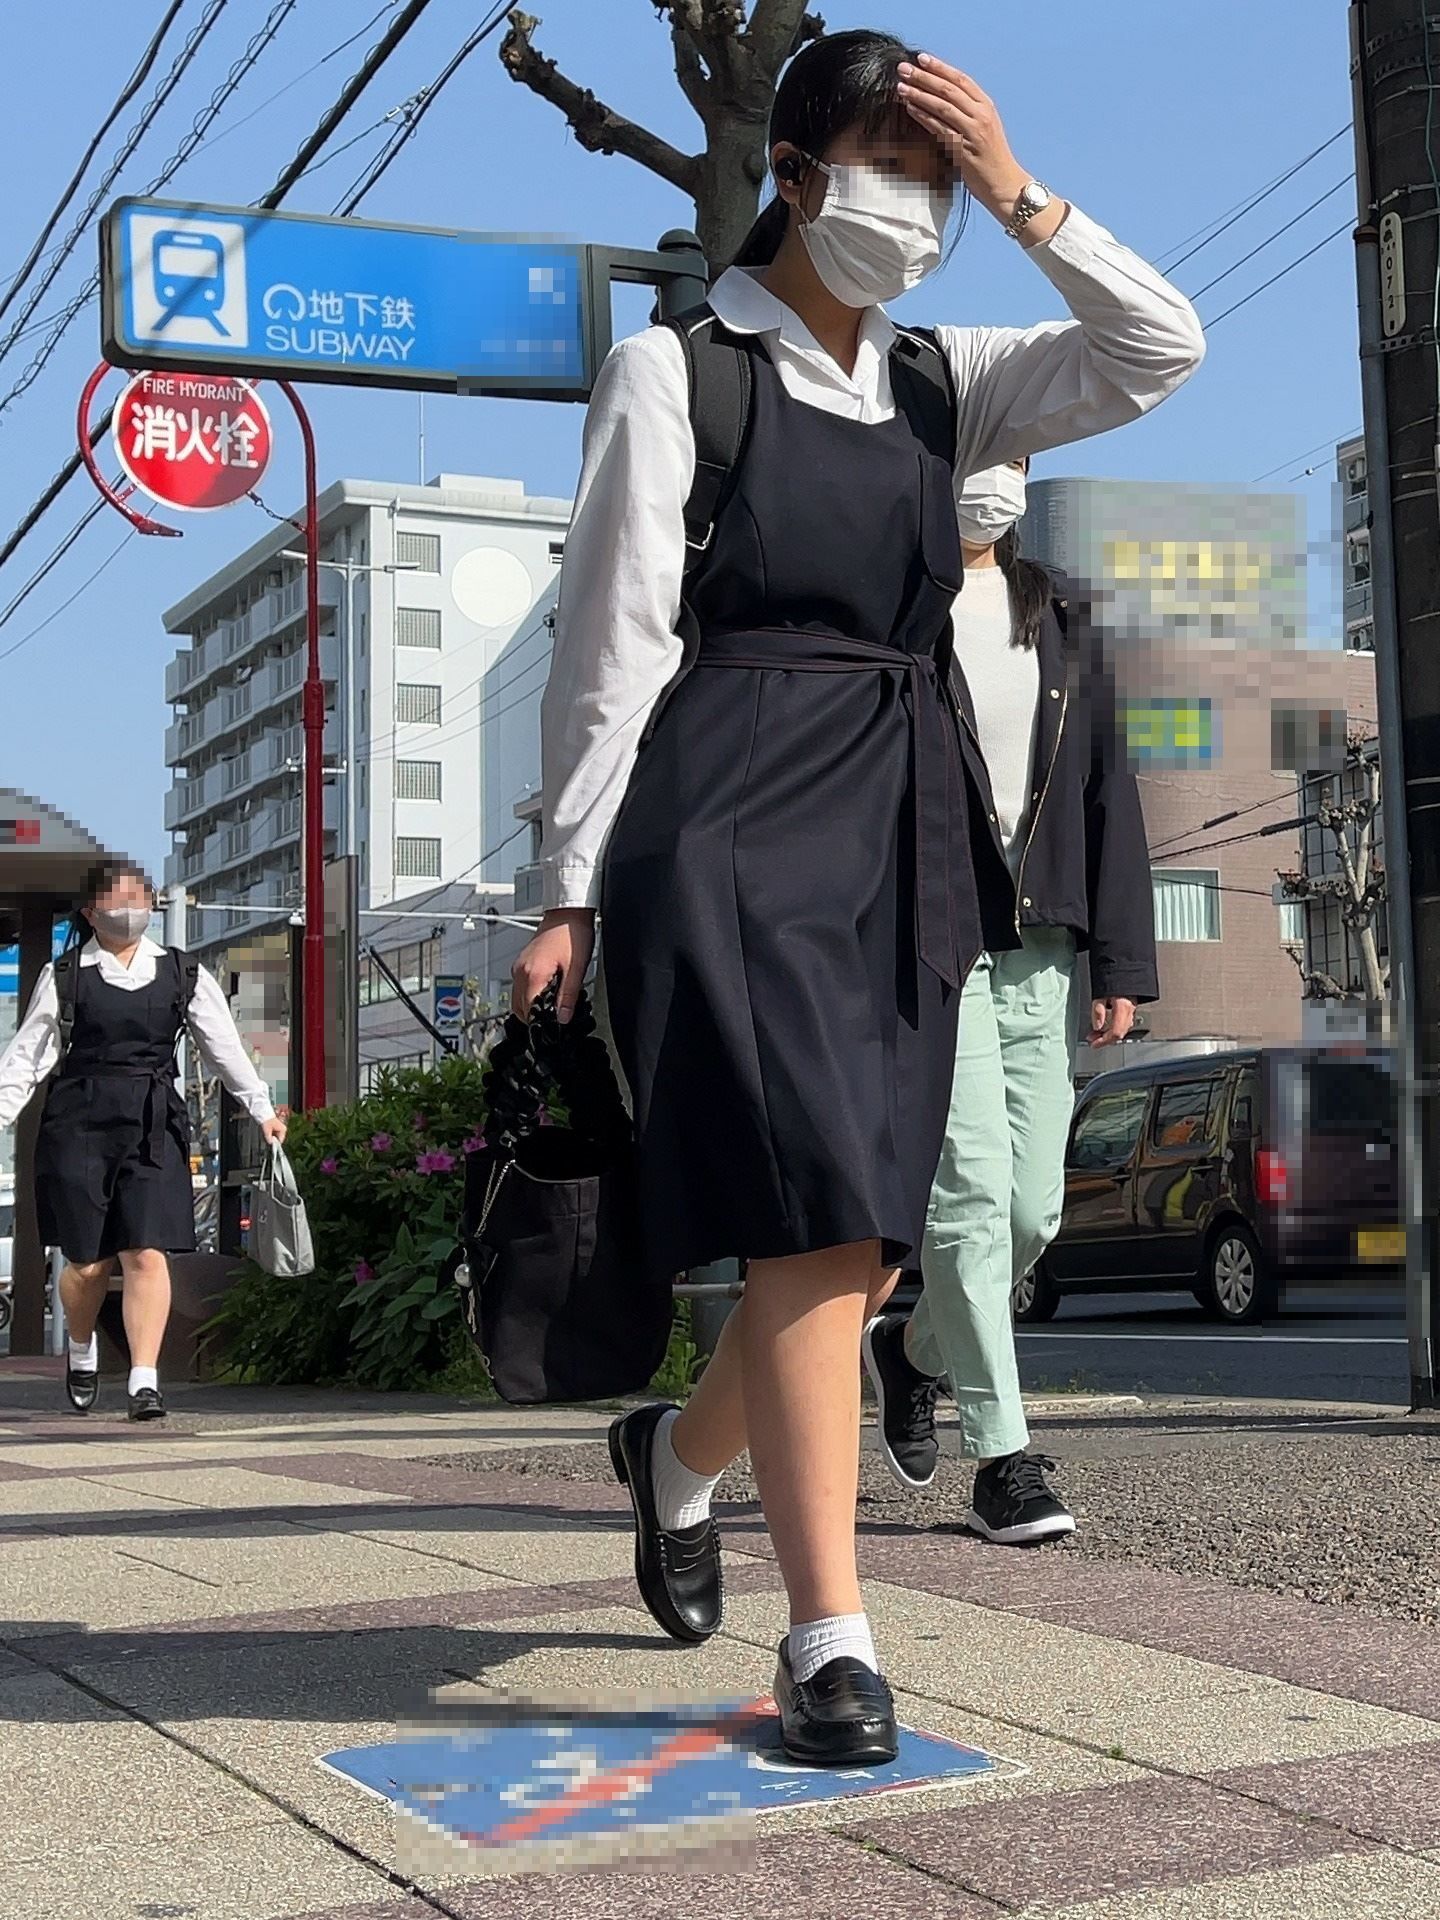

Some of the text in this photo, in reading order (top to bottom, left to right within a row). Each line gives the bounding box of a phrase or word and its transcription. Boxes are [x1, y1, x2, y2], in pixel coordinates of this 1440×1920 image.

[309, 289, 416, 331] 地下鉄
[265, 325, 416, 361] SUBWAY
[143, 378, 246, 403] FIRE HYDRANT
[130, 402, 261, 468] 消火栓
